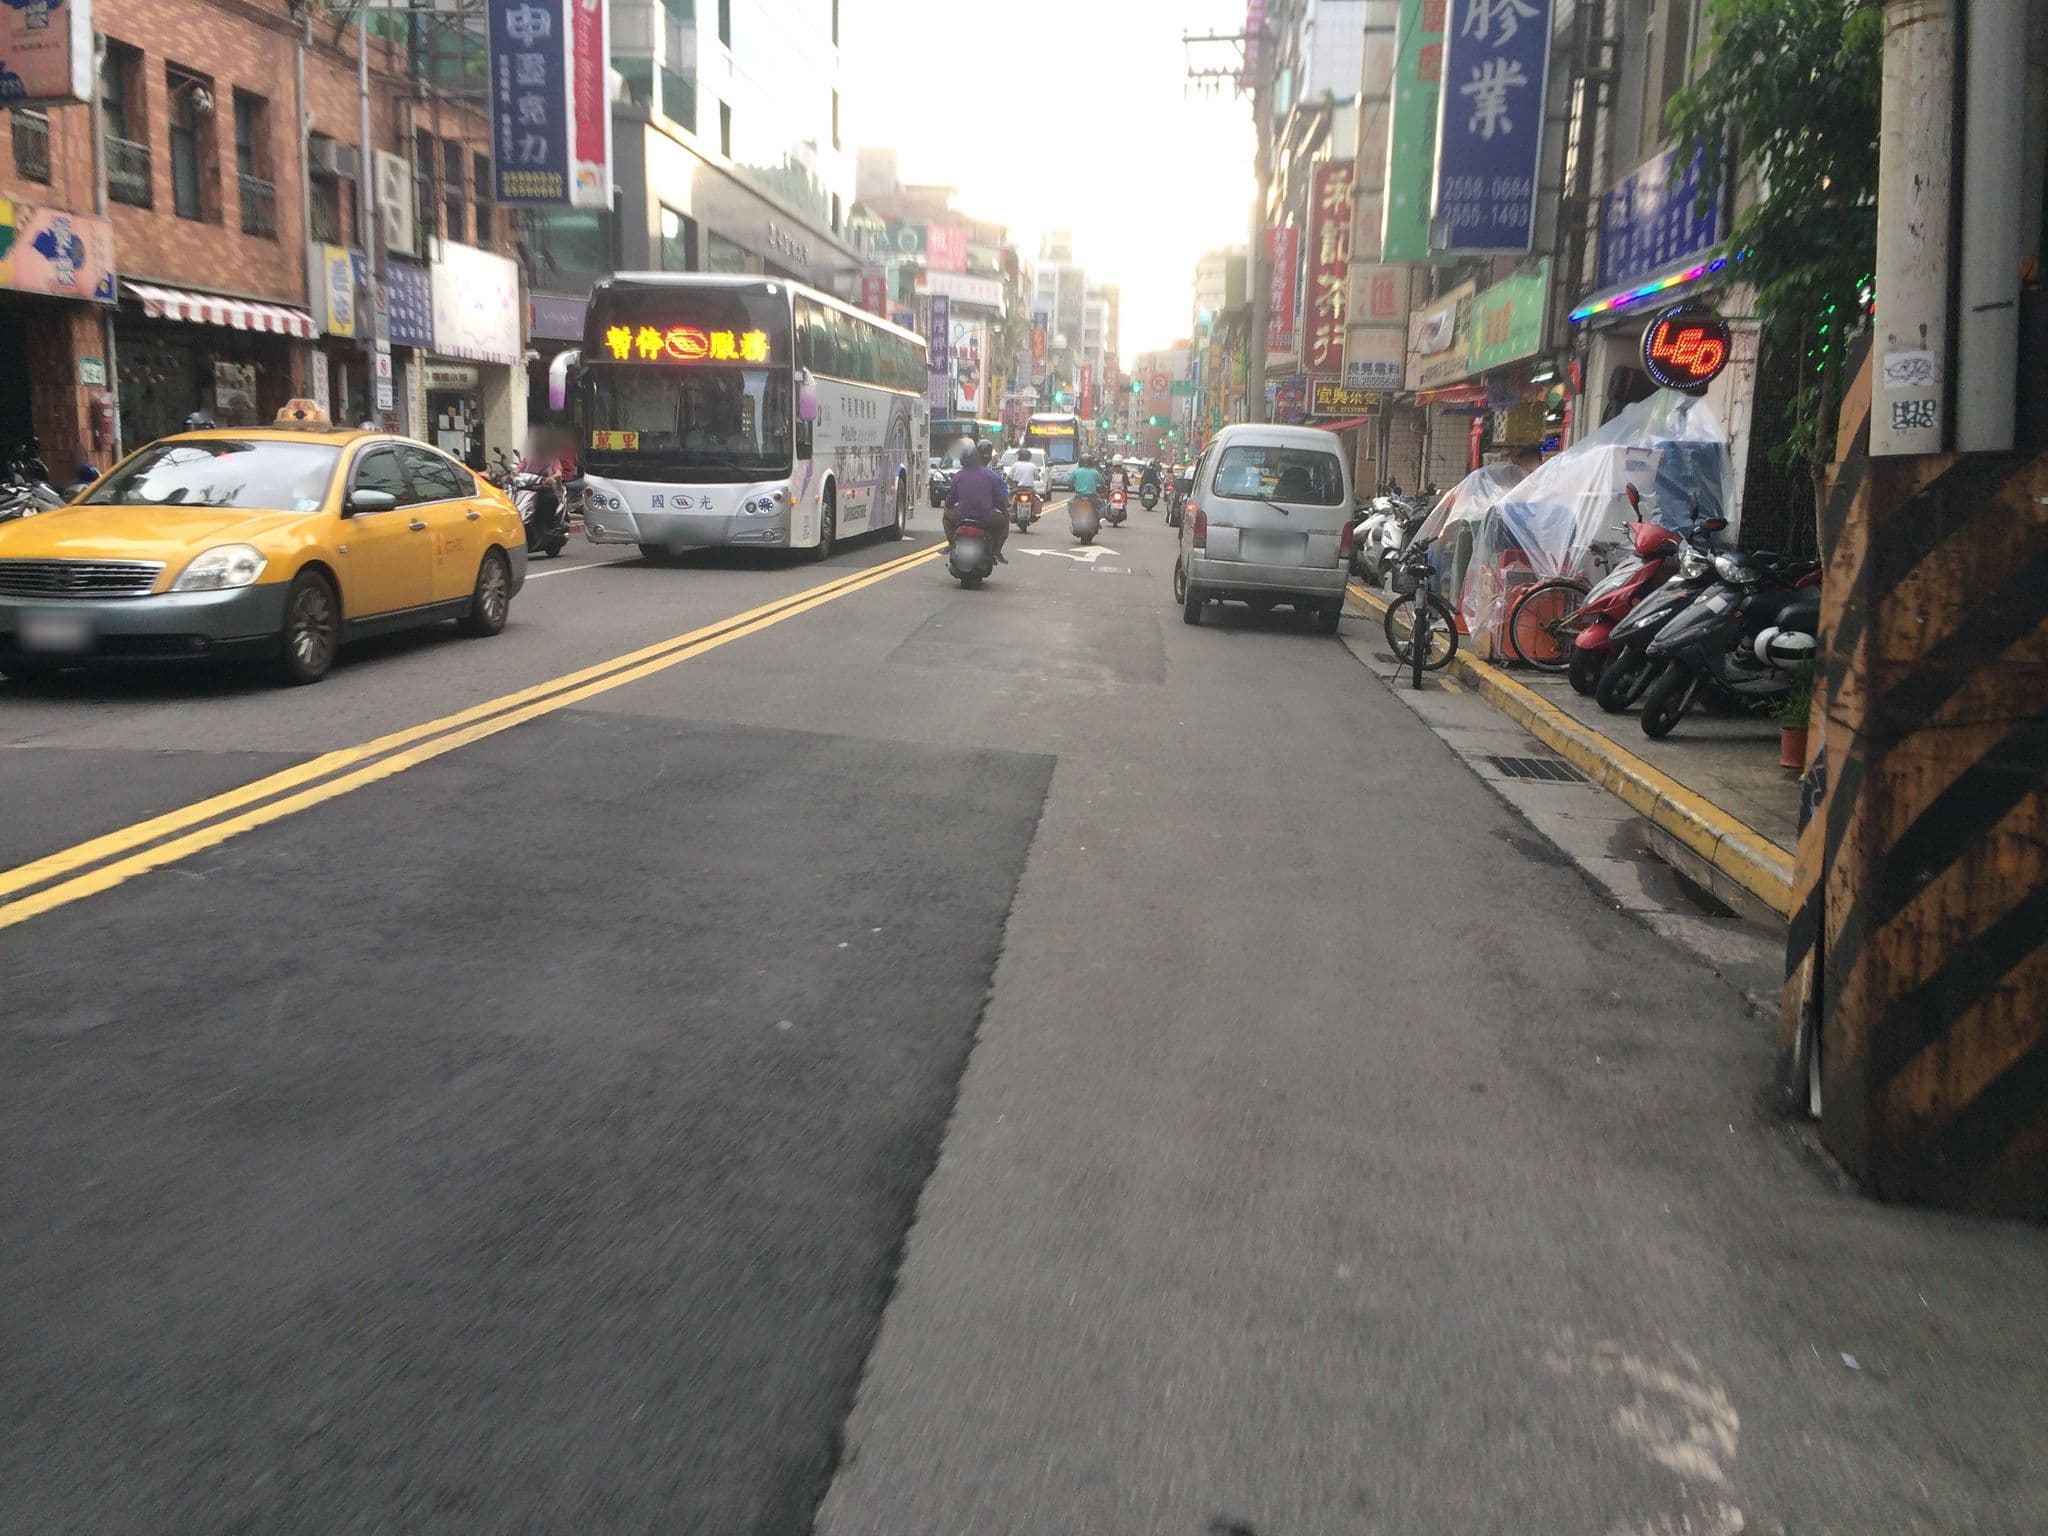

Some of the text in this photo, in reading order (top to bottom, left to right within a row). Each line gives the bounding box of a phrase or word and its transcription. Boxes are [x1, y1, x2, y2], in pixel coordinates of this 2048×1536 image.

[605, 326, 770, 361] 暫停 服務
[1652, 321, 1724, 376] LED
[595, 431, 636, 449] 萬里
[652, 494, 713, 510] 國 光
